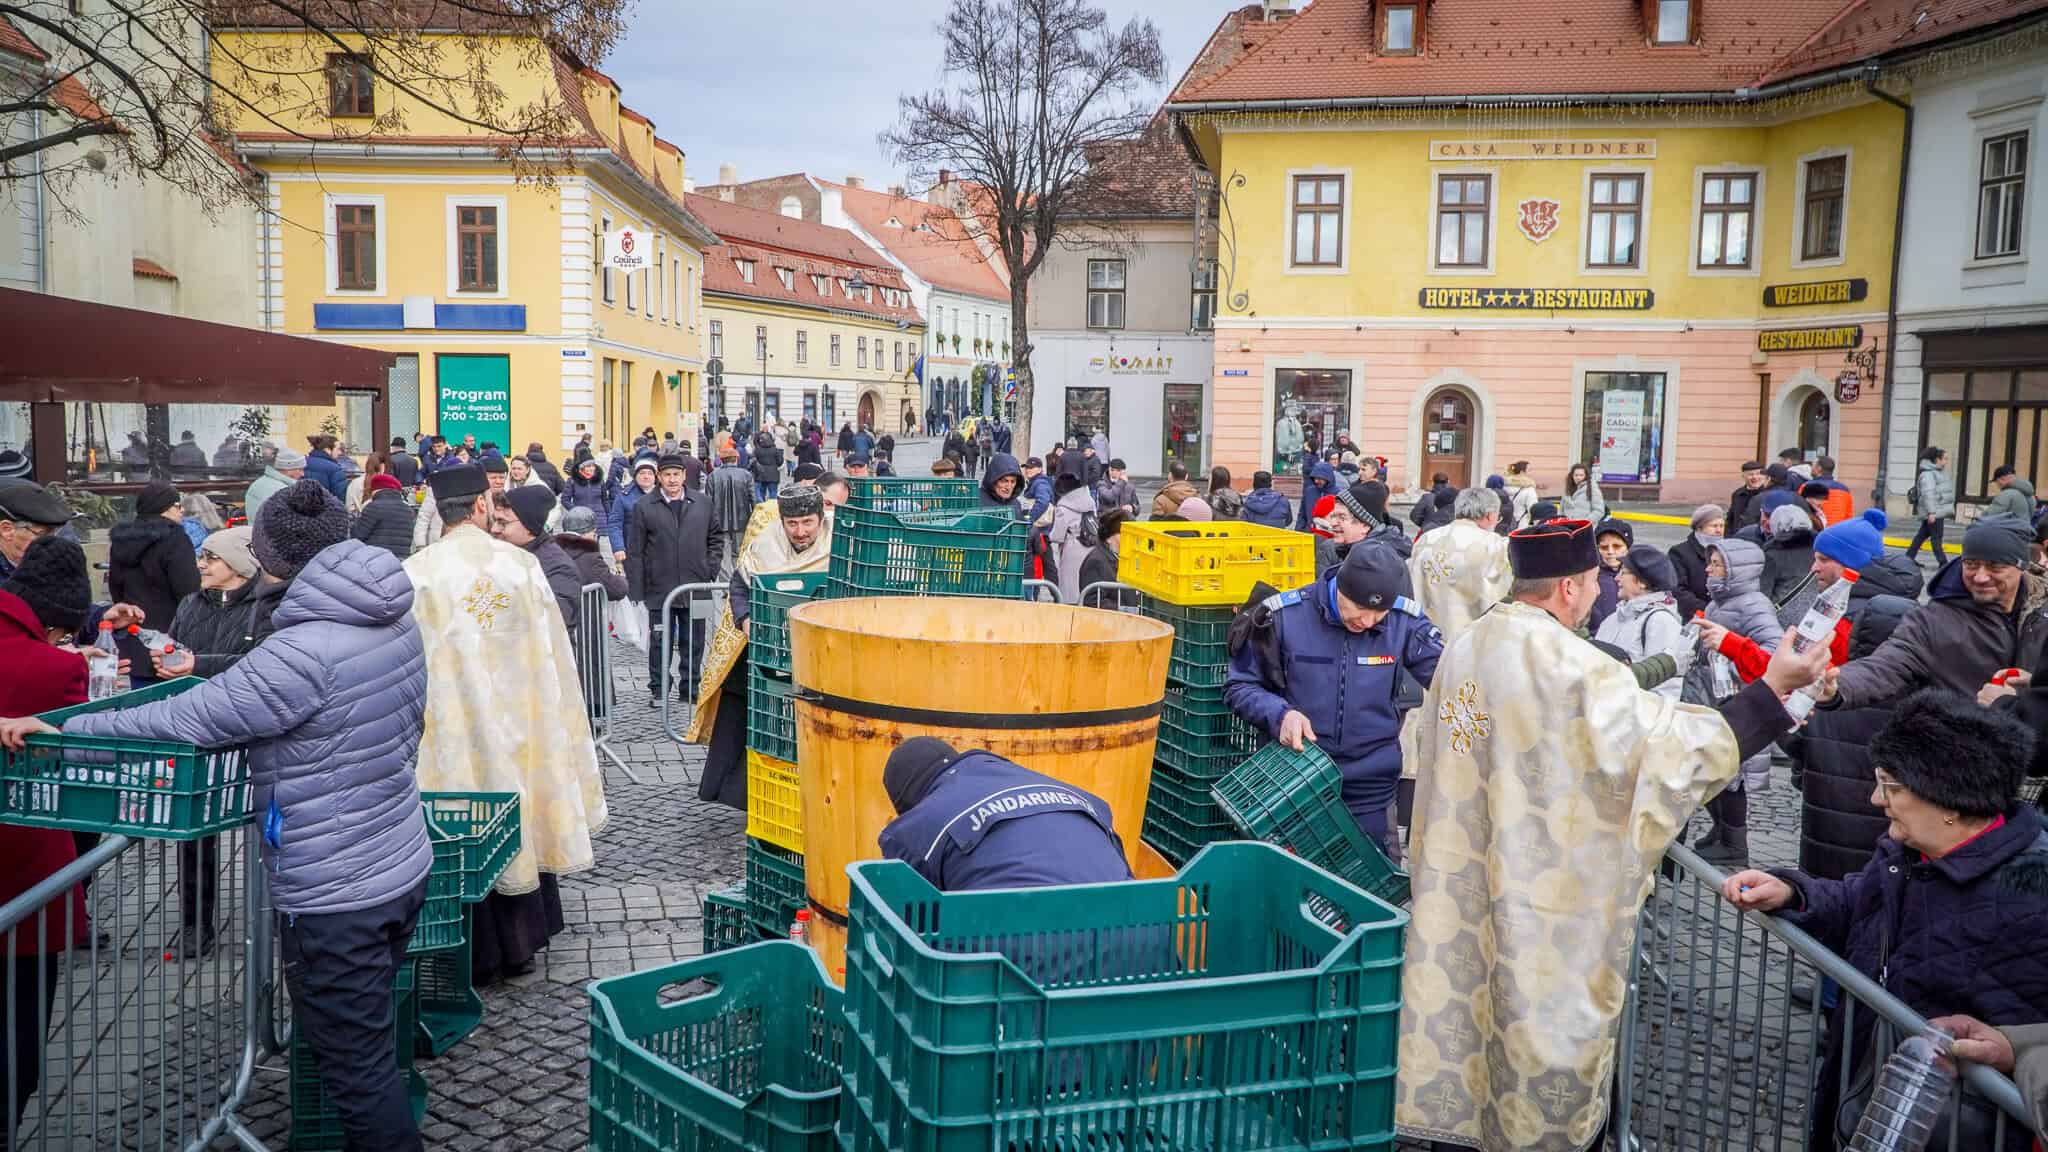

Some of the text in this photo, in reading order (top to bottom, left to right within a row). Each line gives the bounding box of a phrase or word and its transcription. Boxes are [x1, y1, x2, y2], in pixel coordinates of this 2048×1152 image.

[1440, 143, 1647, 156] CASA WEIDNER
[613, 255, 642, 264] Council
[1425, 289, 1648, 308] HOTEL RESTAURANT
[1775, 281, 1851, 305] WEIDNER
[1760, 327, 1857, 349] RESTAURANT
[442, 388, 507, 403] Program
[442, 411, 467, 421] 7:00
[476, 411, 508, 421] 22:00
